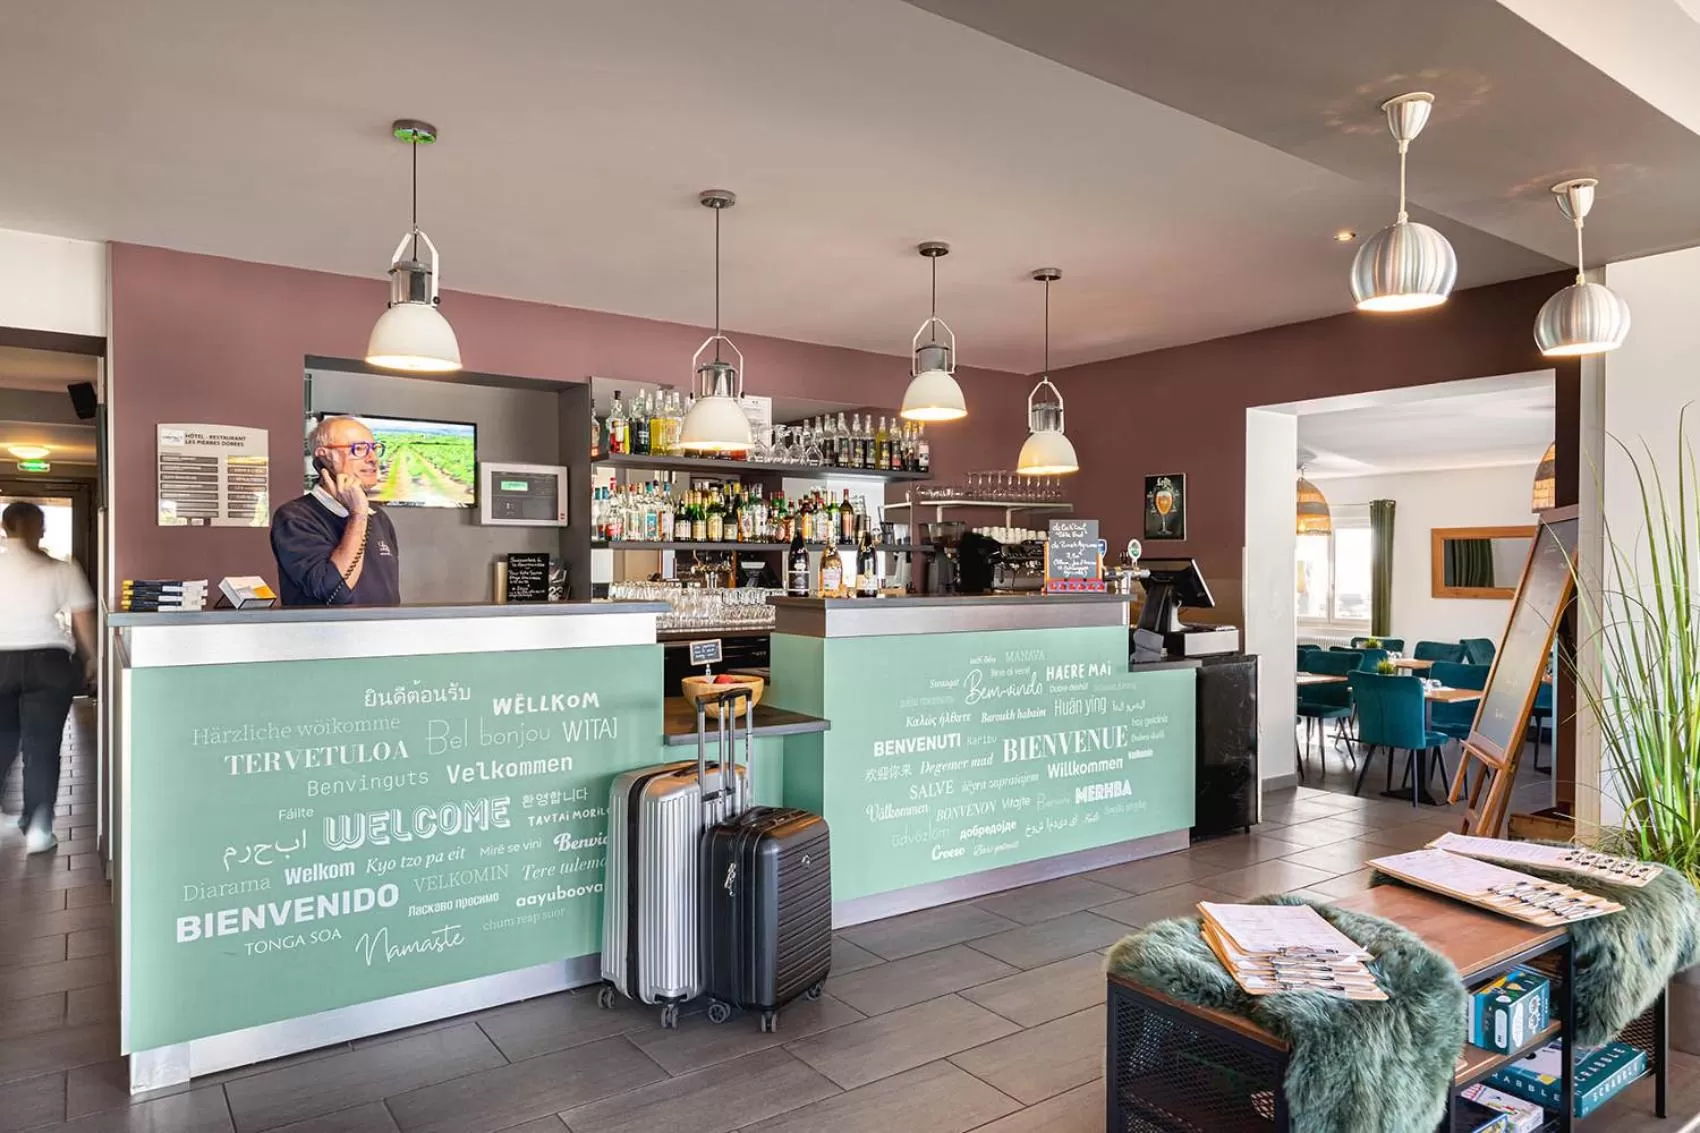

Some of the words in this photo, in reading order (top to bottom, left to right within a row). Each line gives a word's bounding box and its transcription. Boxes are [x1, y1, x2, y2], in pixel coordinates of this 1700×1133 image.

[1046, 664, 1085, 682] HAERE
[192, 721, 293, 746] Härzliche
[425, 717, 468, 756] Bel
[480, 716, 551, 749] bonjou
[562, 716, 618, 743] WITAJ
[873, 732, 961, 758] BENVENUTI
[1003, 724, 1129, 763] BIENVENUE
[224, 740, 409, 776] TERVETULOA
[447, 755, 573, 785] Velkommen
[1048, 757, 1123, 780] Willkommen
[307, 770, 429, 797] Benvinguts
[909, 779, 955, 801] SALVE
[1075, 779, 1133, 805] MERHBA
[278, 807, 315, 821] Fáilte
[323, 796, 511, 851] WELCOME
[284, 861, 356, 886] Welkom
[365, 855, 397, 878] Kyo
[424, 853, 444, 870] pa
[447, 846, 467, 862] eit
[522, 863, 556, 881] Tere
[183, 876, 271, 902] Diarama
[413, 863, 509, 893] VELKOMIN
[176, 883, 400, 943] BIENVENIDO
[244, 933, 307, 956] TONGA
[310, 927, 342, 943] SOA
[354, 924, 466, 966] Namaste
